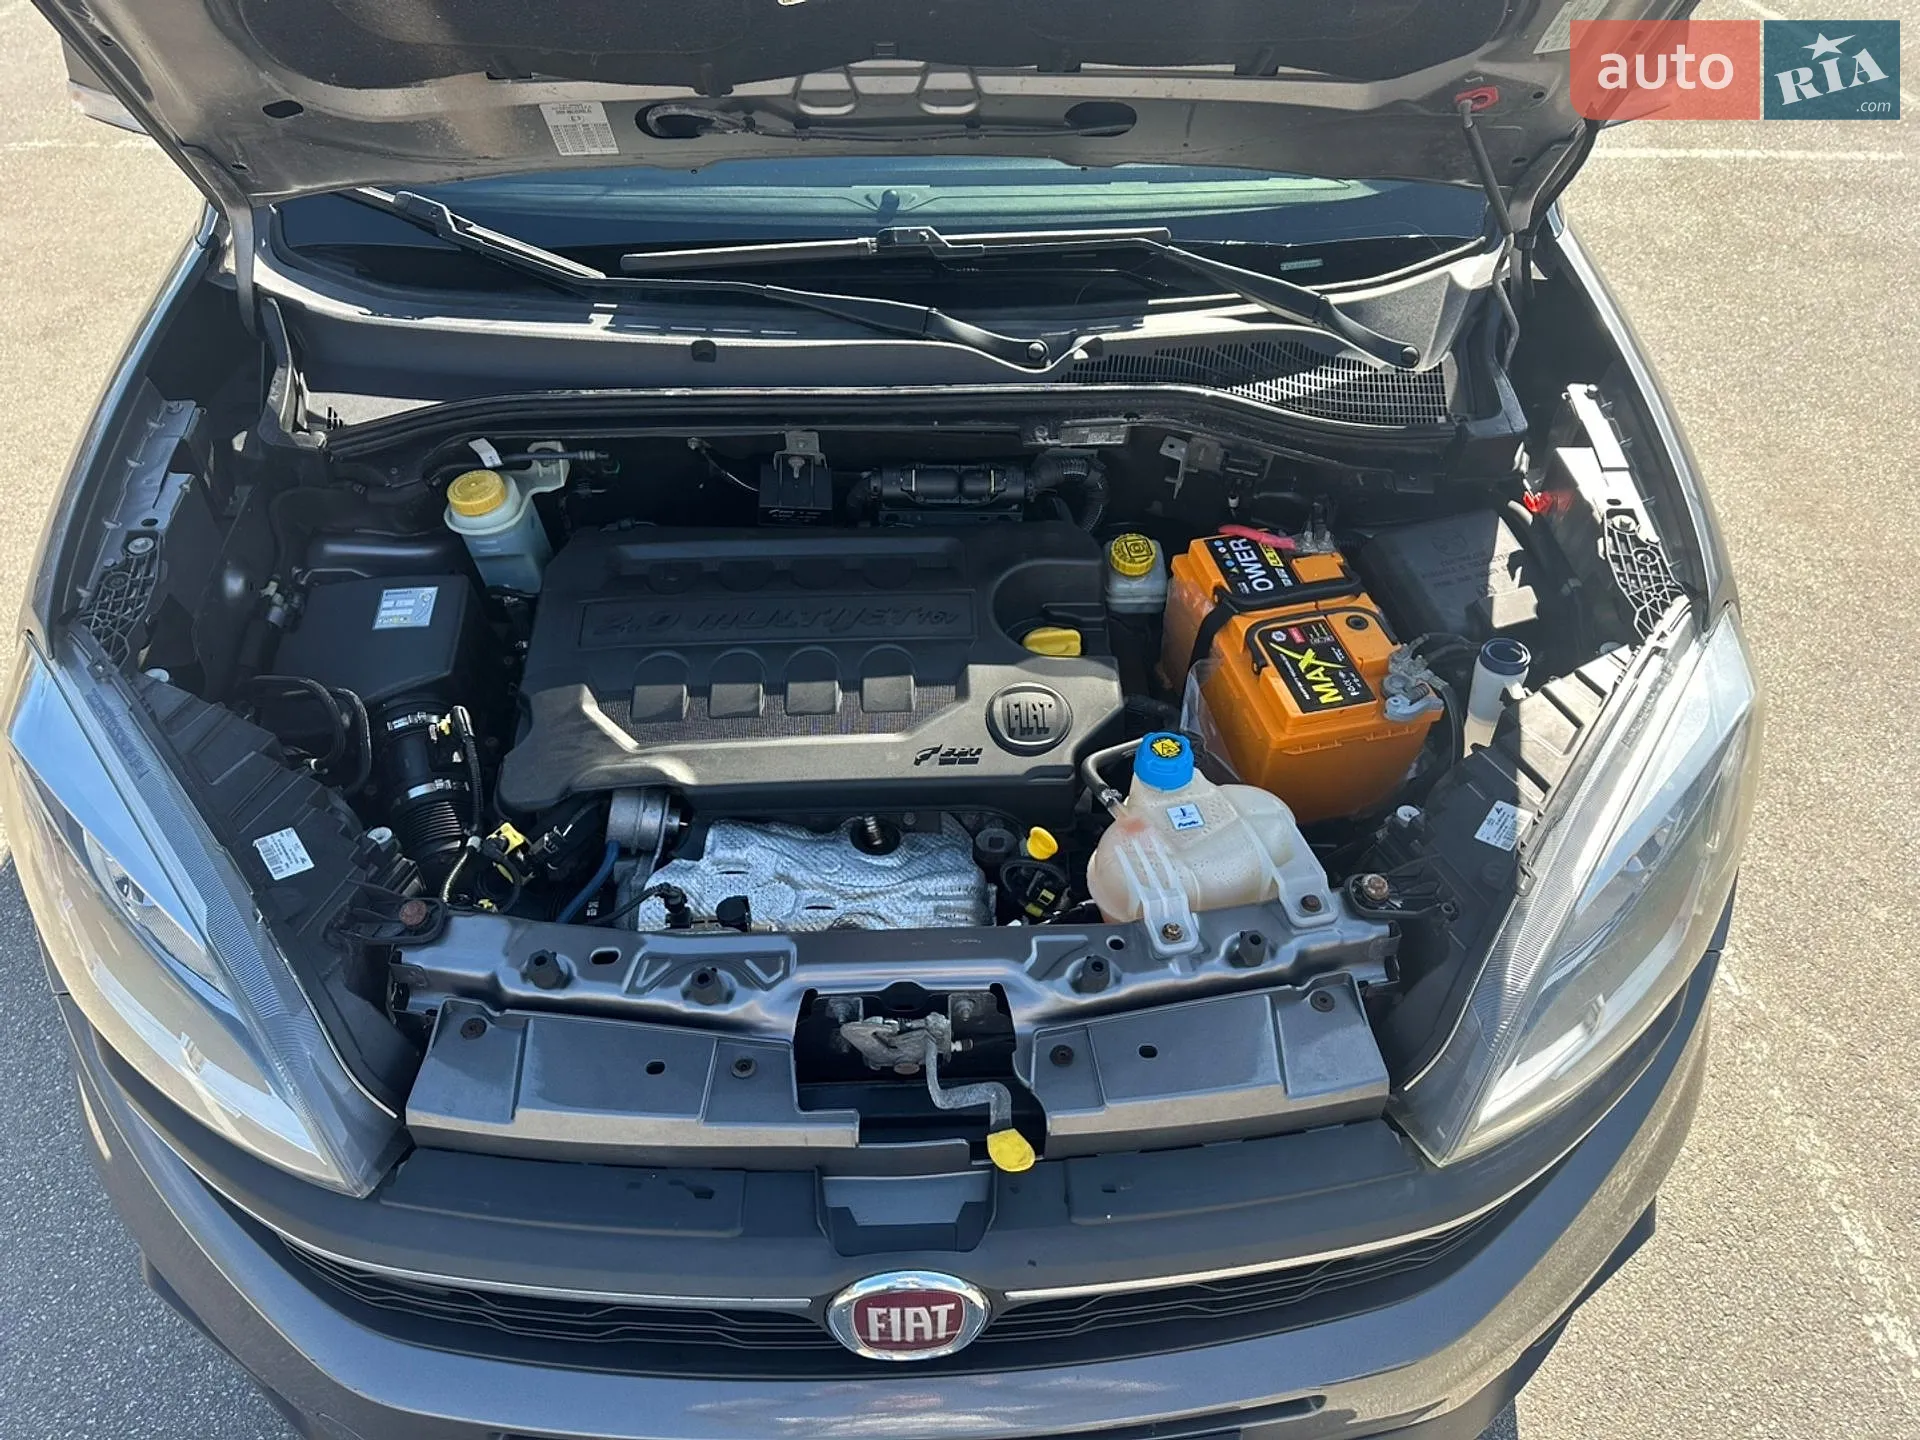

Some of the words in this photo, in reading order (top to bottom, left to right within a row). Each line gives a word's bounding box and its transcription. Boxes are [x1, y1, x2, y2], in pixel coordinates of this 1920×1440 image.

[1229, 538, 1274, 592] OWER
[593, 609, 682, 635] 2.0
[1269, 642, 1347, 704] MAX
[1007, 701, 1053, 737] FIAT
[867, 1303, 956, 1342] FIAT
